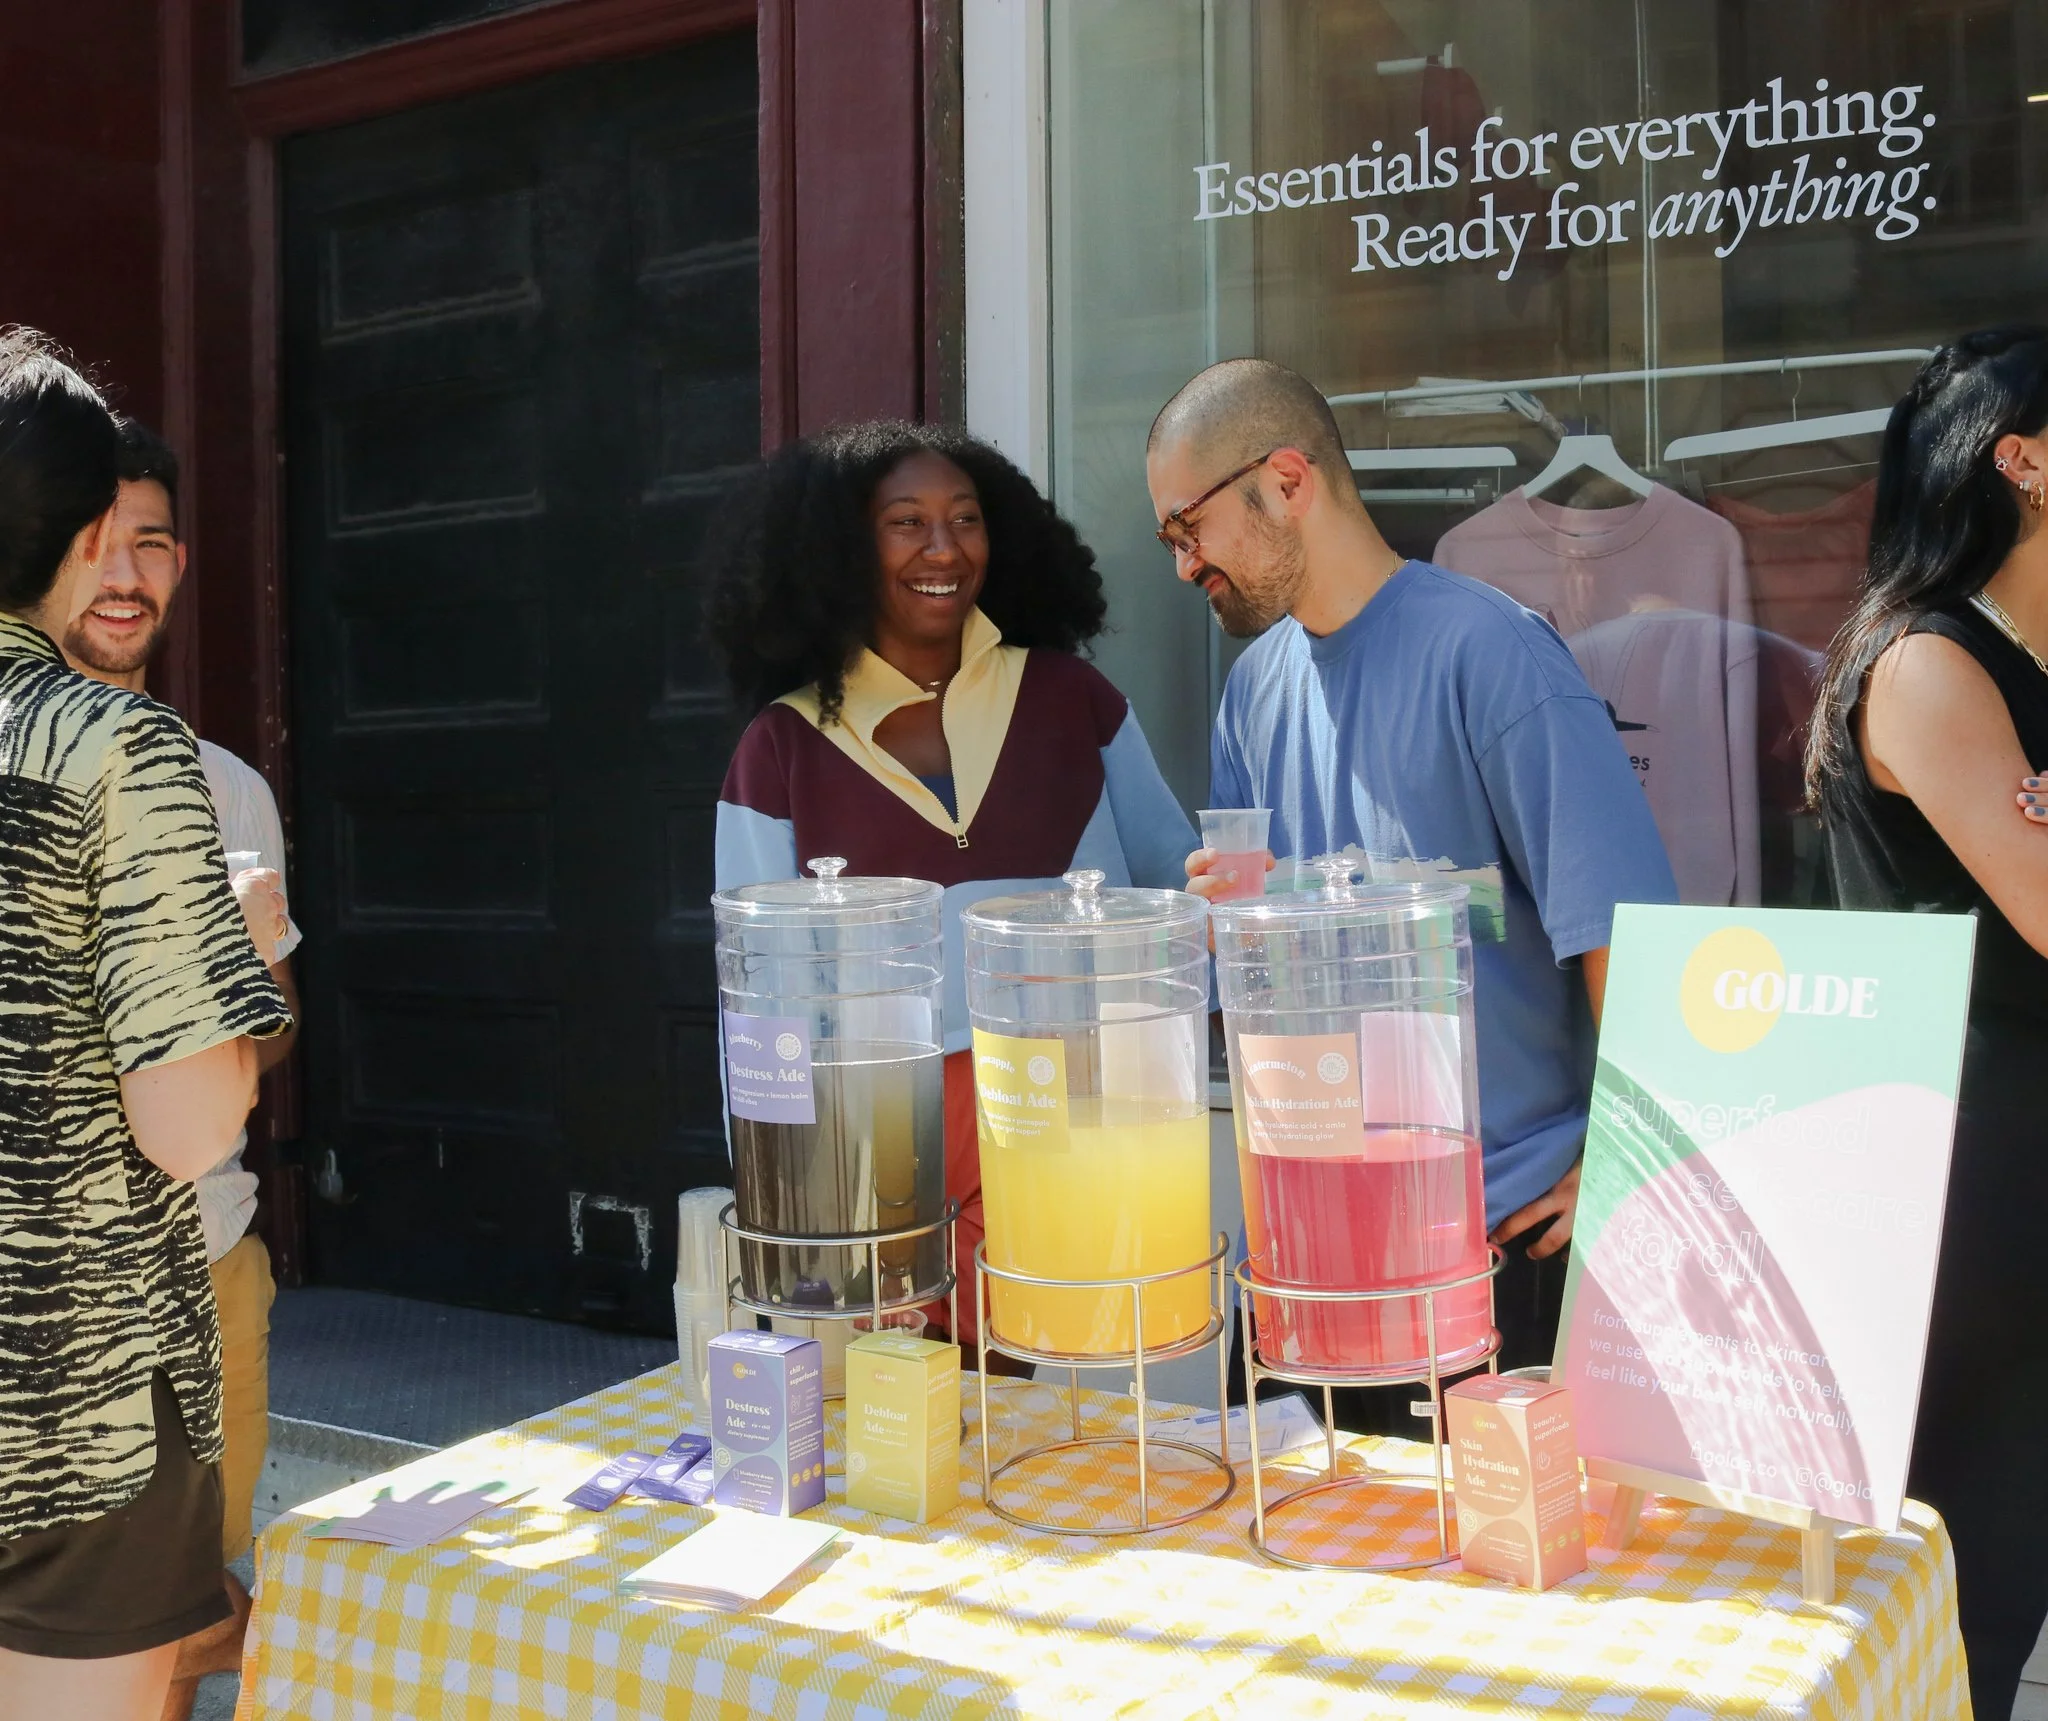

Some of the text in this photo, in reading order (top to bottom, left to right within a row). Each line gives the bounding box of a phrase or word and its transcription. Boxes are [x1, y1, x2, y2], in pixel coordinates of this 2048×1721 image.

[1193, 77, 1936, 221] Essentials for everything.
[1351, 155, 1936, 281] Ready for anything.
[1713, 969, 1880, 1019] GOLDE
[730, 1061, 806, 1082] Destress Ade
[1026, 1092, 1056, 1108] Ade
[1248, 1096, 1359, 1112] Skin Hydration Ade
[1301, 1122, 1317, 1130] acid
[1611, 1095, 1870, 1153] superfood
[1279, 1132, 1313, 1141] hydrating
[1316, 1133, 1334, 1141] glow
[1688, 1167, 1929, 1237] se-care
[1621, 1216, 1766, 1283] for all
[1592, 1309, 1632, 1333] from
[1744, 1338, 1760, 1355] to
[1765, 1342, 1833, 1367] skincar
[1590, 1338, 1611, 1353] we
[1616, 1344, 1643, 1360] use
[1685, 1358, 1784, 1387] superfods
[1789, 1375, 1805, 1391] to
[1810, 1377, 1849, 1404] help
[1584, 1360, 1615, 1381] feel
[1619, 1366, 1647, 1388] like
[1650, 1378, 1688, 1395] your
[1692, 1381, 1729, 1406] bes
[725, 1398, 771, 1416] Destress
[864, 1403, 908, 1422] Debloat
[726, 1415, 746, 1429] Ade
[864, 1420, 885, 1434] Ade
[1533, 1415, 1556, 1430] beauty
[1534, 1421, 1569, 1441] superfoods
[1460, 1438, 1482, 1451] Skin
[1462, 1453, 1520, 1477] Hydration
[1702, 1450, 1777, 1478] golde.co
[1465, 1472, 1486, 1488] Ade
